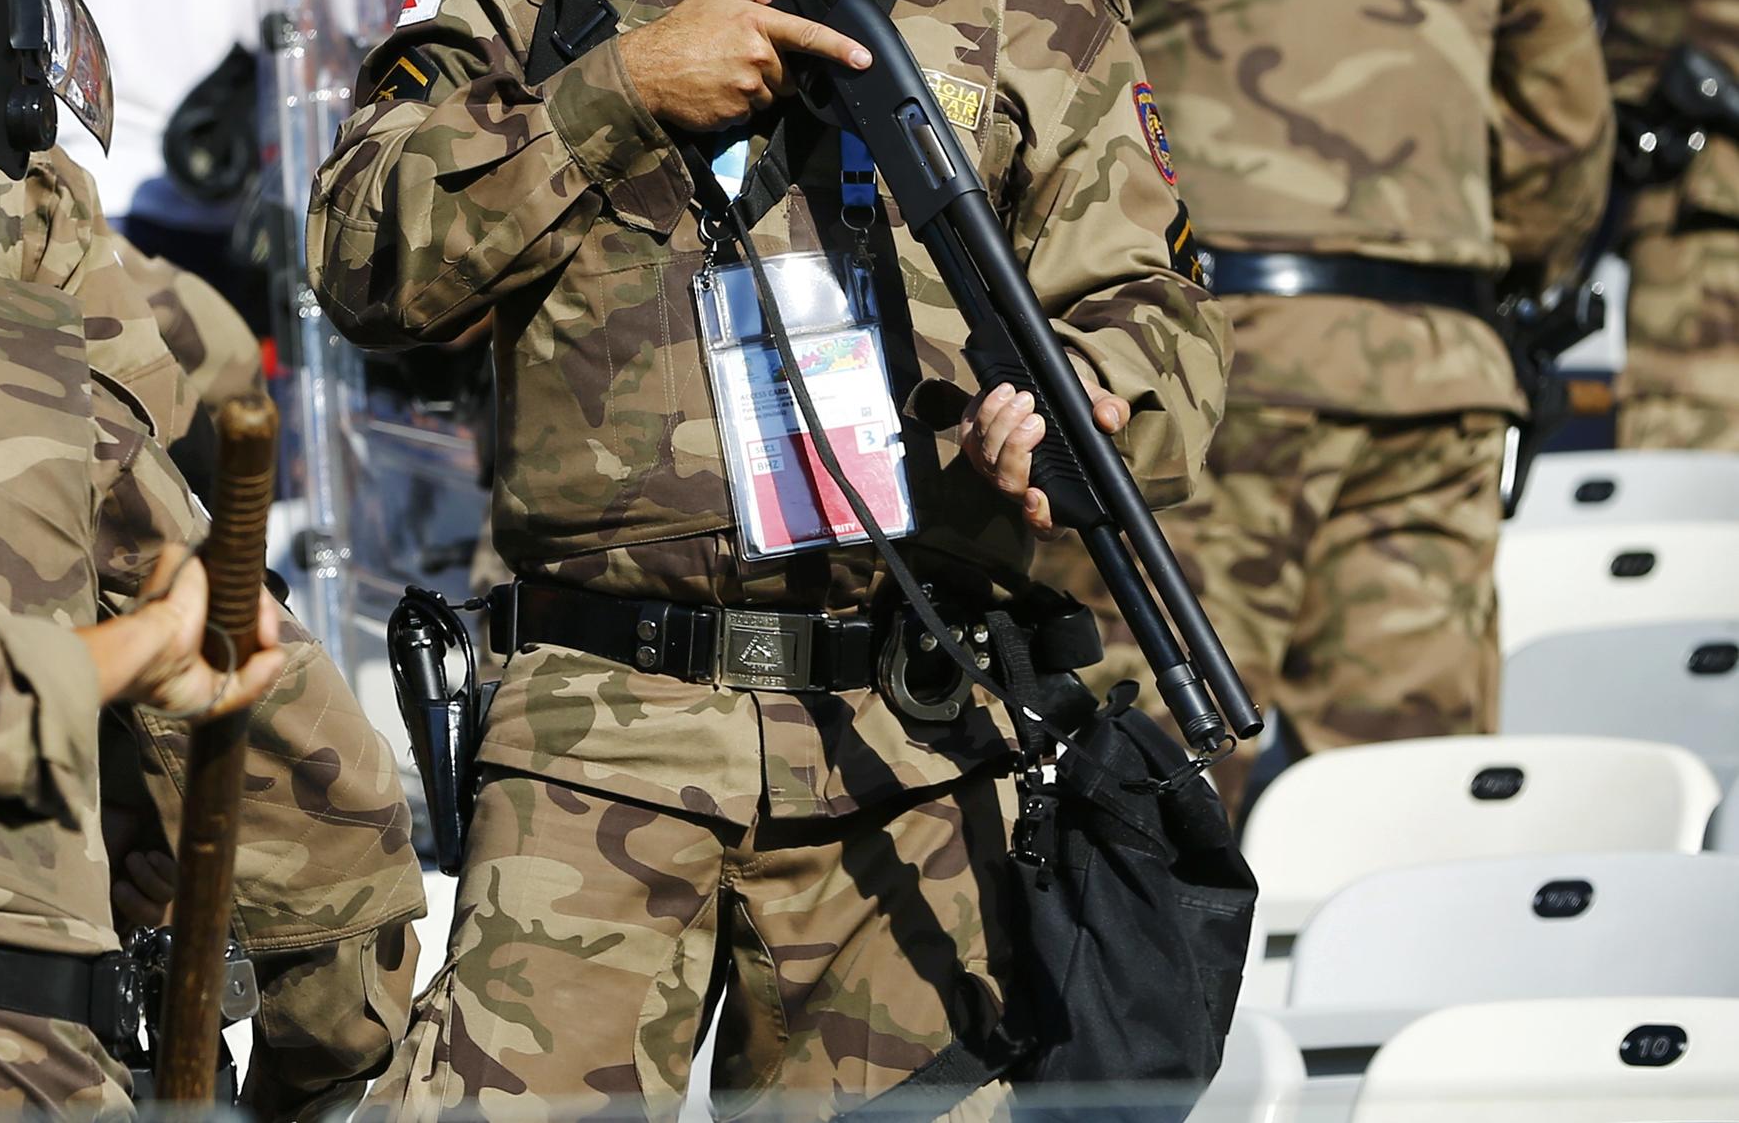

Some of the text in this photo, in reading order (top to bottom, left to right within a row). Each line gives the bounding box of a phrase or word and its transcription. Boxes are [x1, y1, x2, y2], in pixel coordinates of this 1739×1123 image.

[768, 386, 789, 395] CARD
[862, 430, 876, 445] 3
[757, 459, 780, 472] BHZ
[811, 522, 856, 537] SECURITY
[1639, 1037, 1670, 1058] 10
